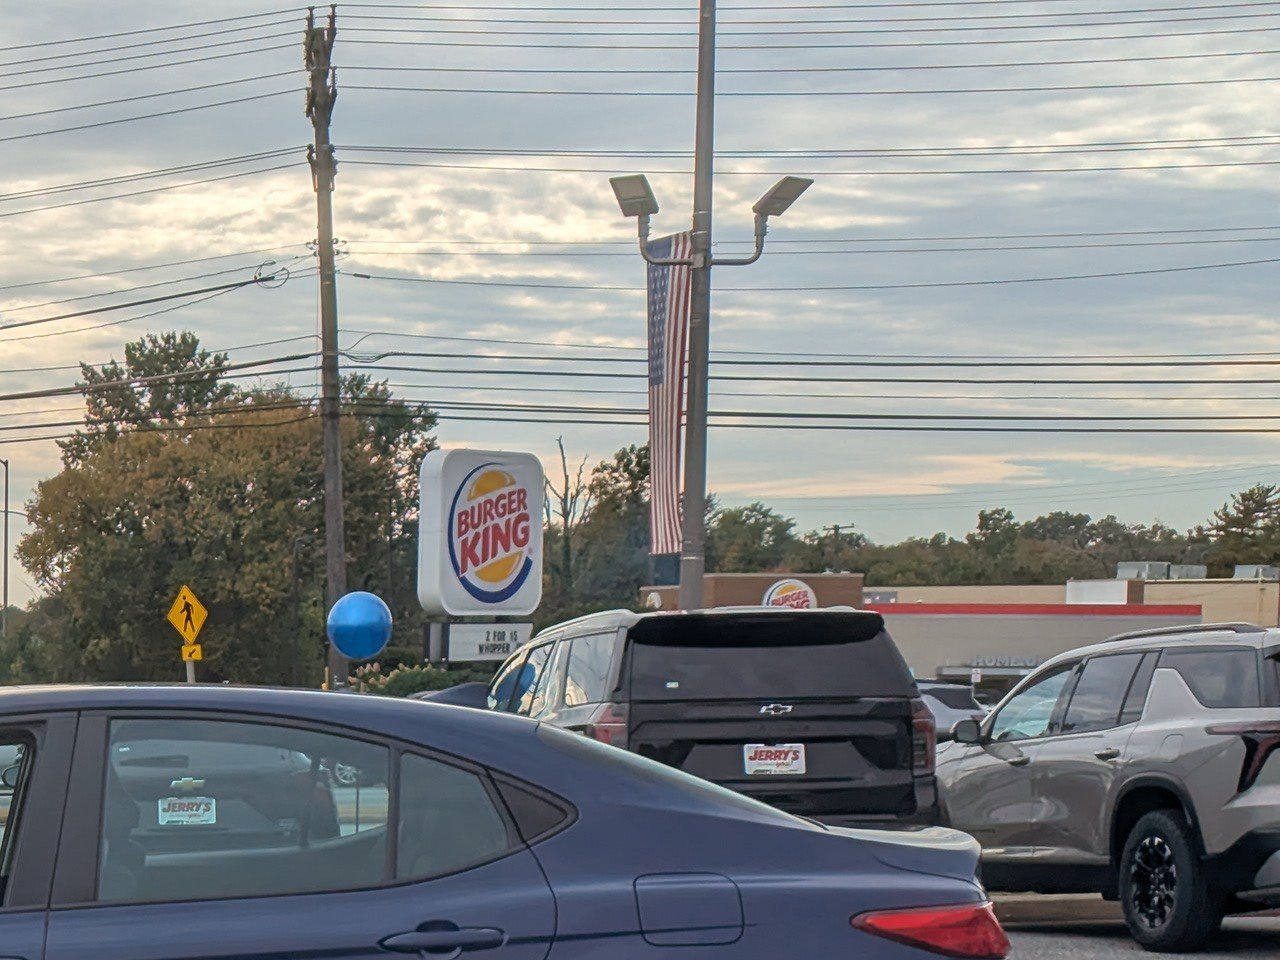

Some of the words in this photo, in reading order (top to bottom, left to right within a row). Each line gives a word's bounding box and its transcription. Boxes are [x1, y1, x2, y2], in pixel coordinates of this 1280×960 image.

[457, 487, 528, 540] BURGER
[459, 512, 530, 576] KING
[771, 590, 809, 606] BURGER
[486, 630, 491, 642] 2
[493, 630, 506, 641] FOR
[478, 642, 511, 654] WHOPPER
[748, 749, 800, 761] JERRY'S
[162, 801, 212, 813] JERRY'S
